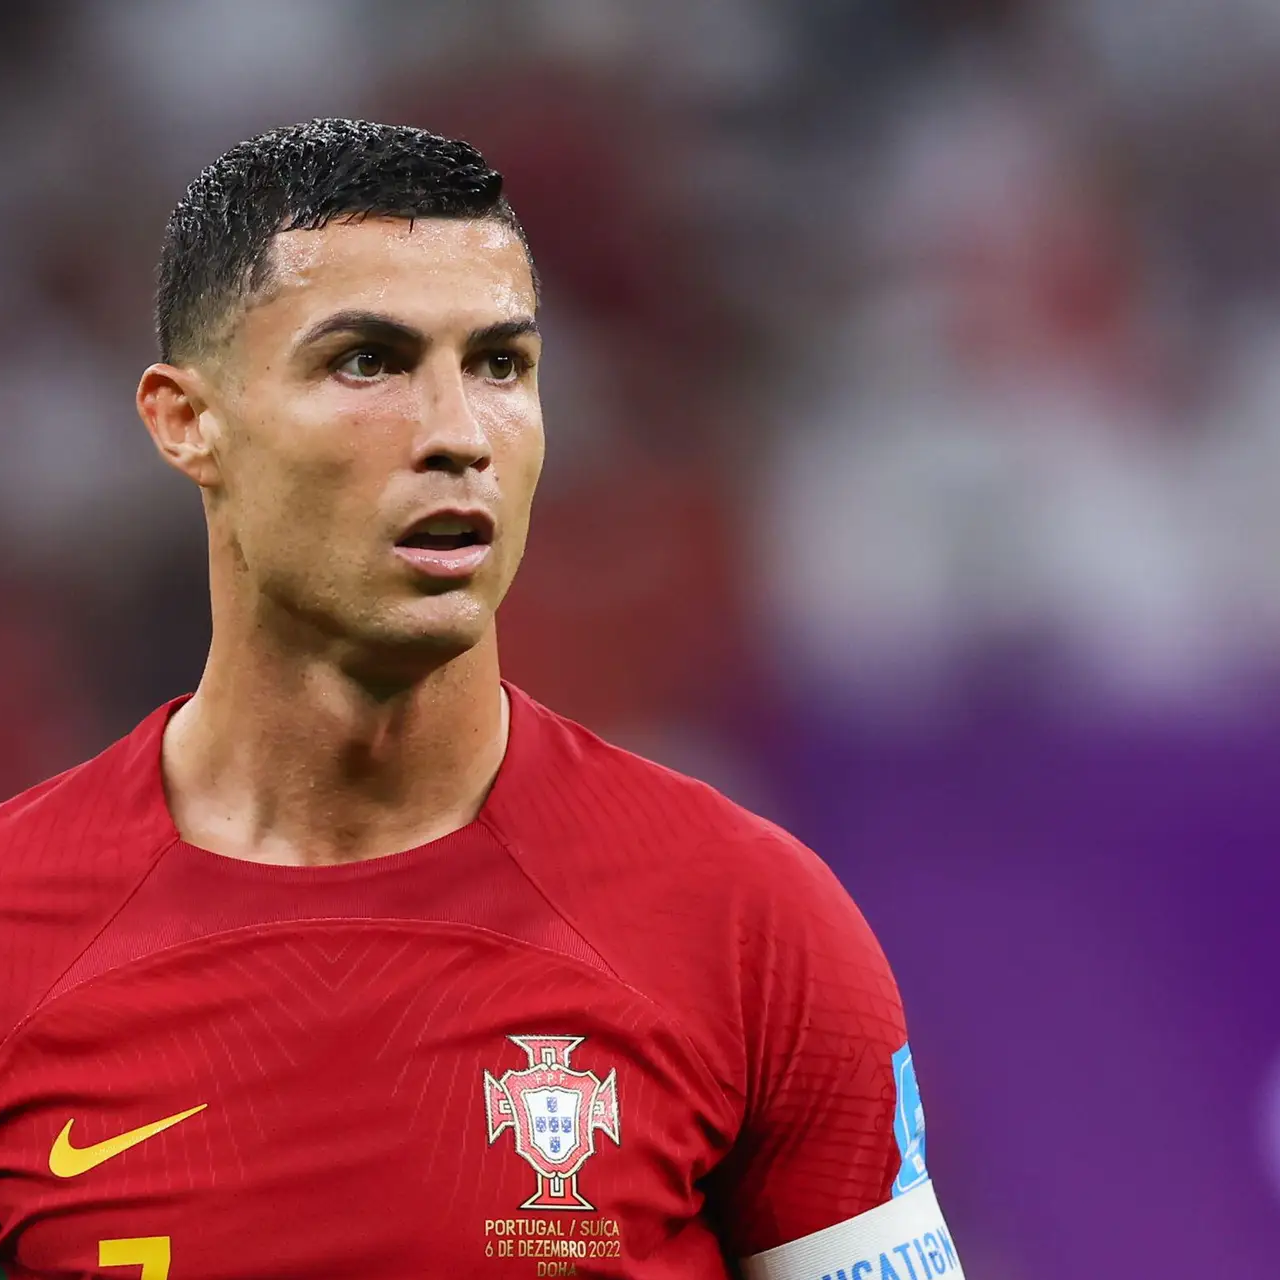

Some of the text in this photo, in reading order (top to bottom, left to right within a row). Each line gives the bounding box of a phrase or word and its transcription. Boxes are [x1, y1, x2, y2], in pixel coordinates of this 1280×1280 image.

[485, 1219, 565, 1237] PORTUGAL
[580, 1217, 620, 1238] SUÍÇA
[484, 1240, 620, 1258] 6 DE DEZEMBRO 2022
[537, 1261, 577, 1277] DOHA
